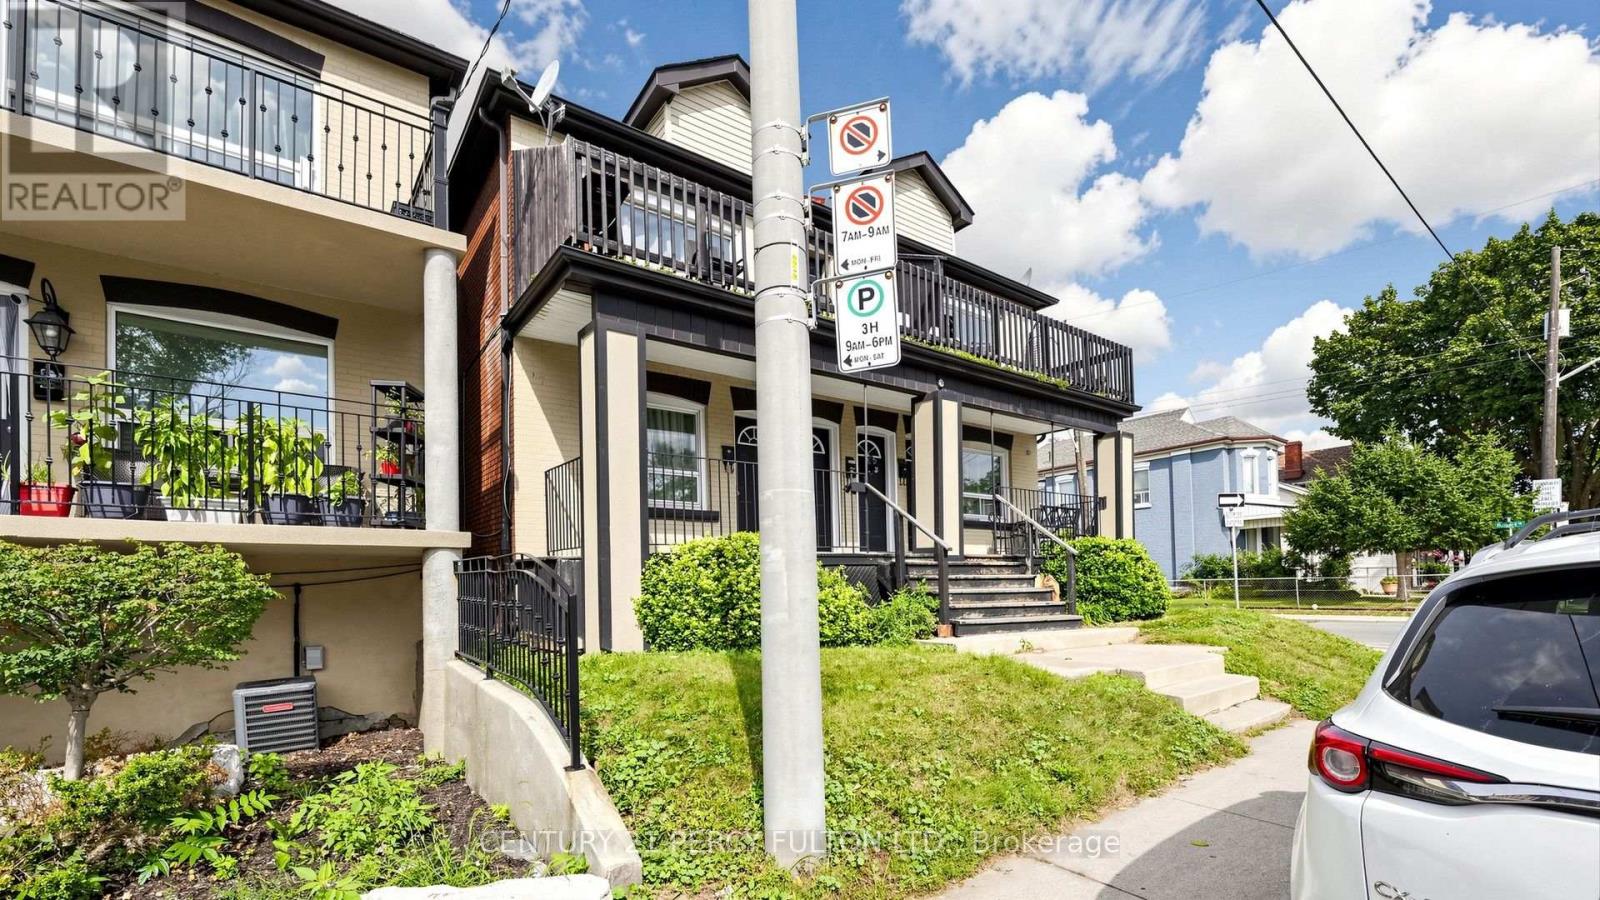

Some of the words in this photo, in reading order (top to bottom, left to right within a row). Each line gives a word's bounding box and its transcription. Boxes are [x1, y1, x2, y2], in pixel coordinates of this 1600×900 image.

[841, 226, 890, 242] 7AM-9AM
[858, 287, 875, 311] P
[861, 321, 879, 335] 3H
[845, 335, 893, 352] 9AM-6PM
